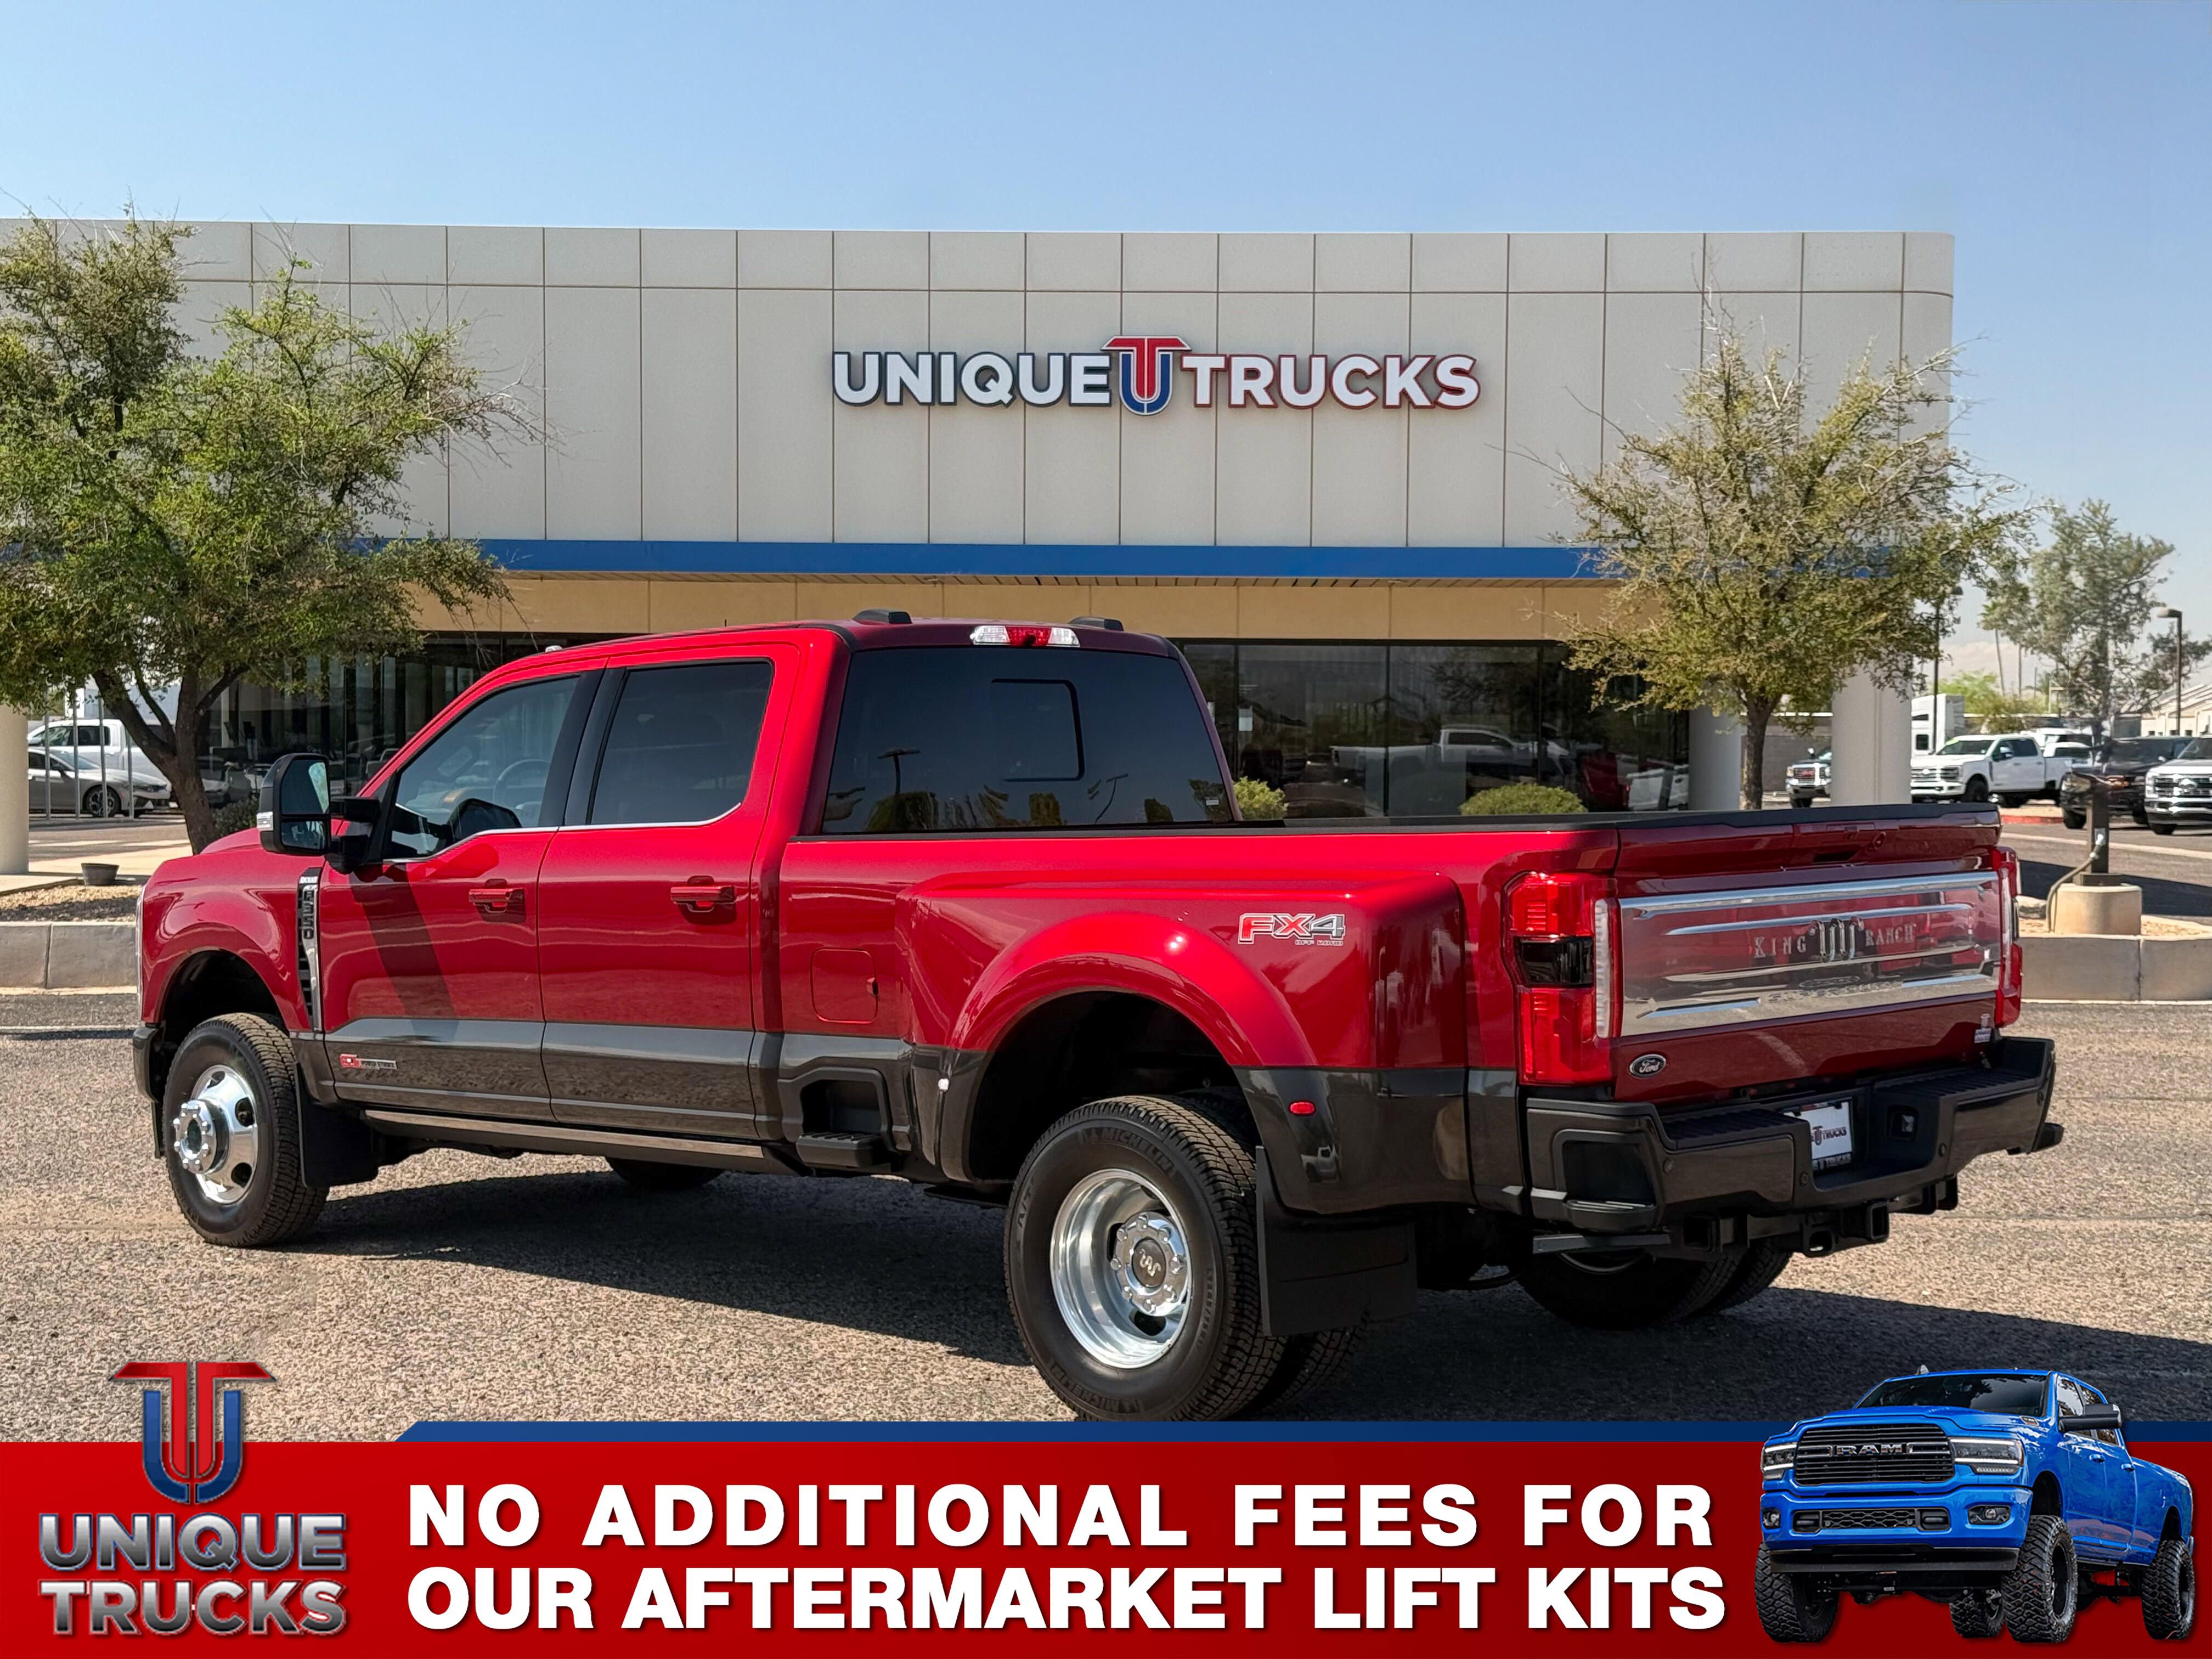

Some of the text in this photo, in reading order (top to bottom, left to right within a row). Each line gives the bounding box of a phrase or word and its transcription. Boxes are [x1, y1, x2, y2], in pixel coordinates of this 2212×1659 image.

[832, 352, 1112, 408] UNIQUE
[1182, 354, 1481, 409] TRUCKS
[1238, 913, 1346, 944] FX4
[1753, 923, 1914, 958] KING RANCH
[1639, 1059, 1661, 1073] Ford
[1101, 1126, 1175, 1172] MICHELIN
